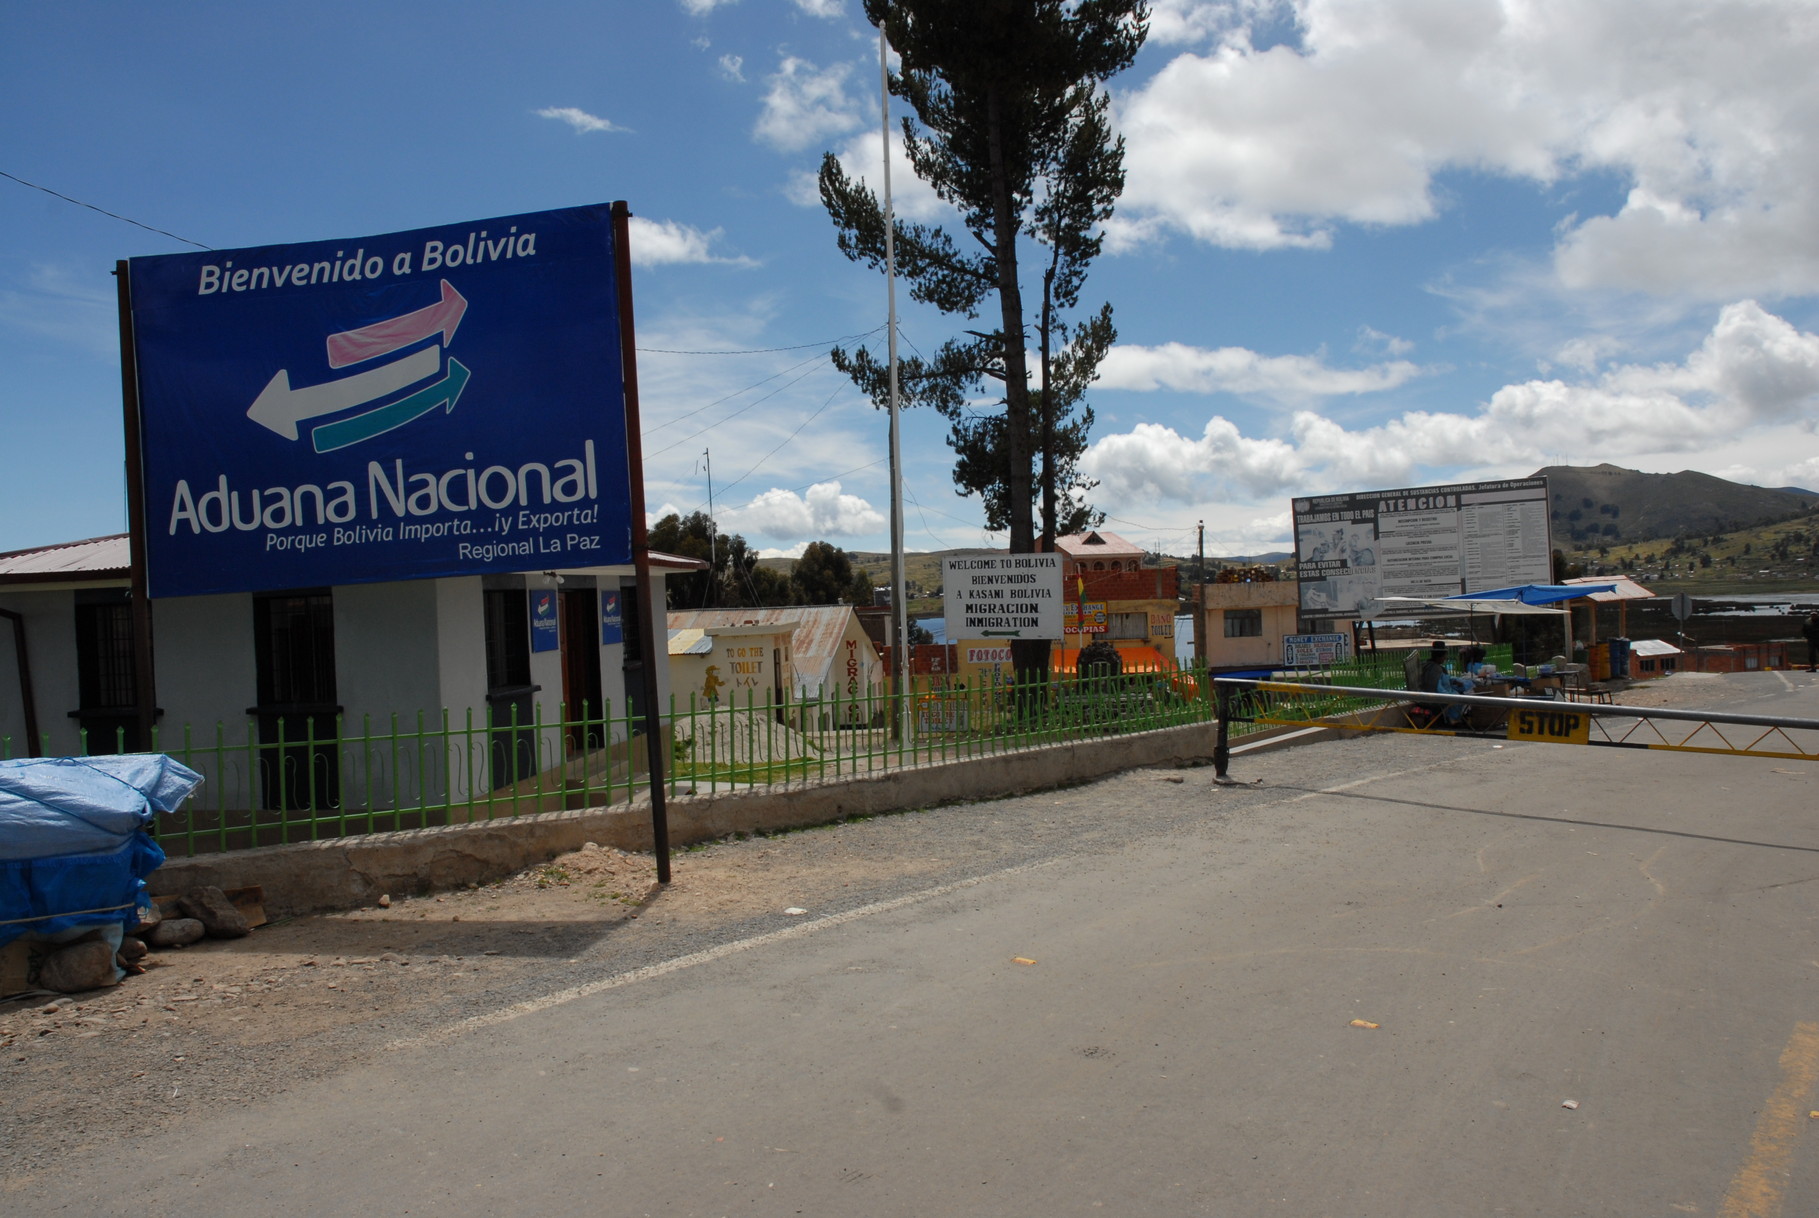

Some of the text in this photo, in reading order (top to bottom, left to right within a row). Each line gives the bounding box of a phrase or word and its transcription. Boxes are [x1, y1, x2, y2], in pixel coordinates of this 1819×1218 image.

[198, 226, 537, 296] Bienvenido a Bolivia
[168, 439, 599, 536] Aduana Nacional
[1510, 480, 1544, 488] Operaciones
[1378, 495, 1456, 512] ATENCION
[1297, 512, 1332, 524] TRABAJAMOS
[1332, 512, 1340, 520] EN
[1340, 510, 1354, 520] TODO
[1355, 510, 1361, 519] EL
[1362, 509, 1374, 518] PAIS
[265, 532, 328, 554] Porque
[332, 524, 394, 546] Bolivia
[517, 504, 599, 535] Exporta!
[458, 532, 601, 564] Regional La Paz
[949, 558, 1056, 570] WELCOME TO BOLIVIA
[1299, 560, 1340, 570] PARA EVITAR
[972, 574, 1036, 585] BIENVENIDOS
[956, 589, 1052, 599] A KASANI BOLIVIA
[965, 603, 1039, 614] MIGRACION
[966, 617, 1039, 628] INMIGRATION
[1151, 625, 1172, 636] TOILET
[726, 647, 763, 658] TO GO THE
[730, 661, 763, 674] TOILET
[736, 677, 759, 688] トイレ
[846, 640, 859, 723] MIGRACON
[1520, 710, 1580, 737] STOP
